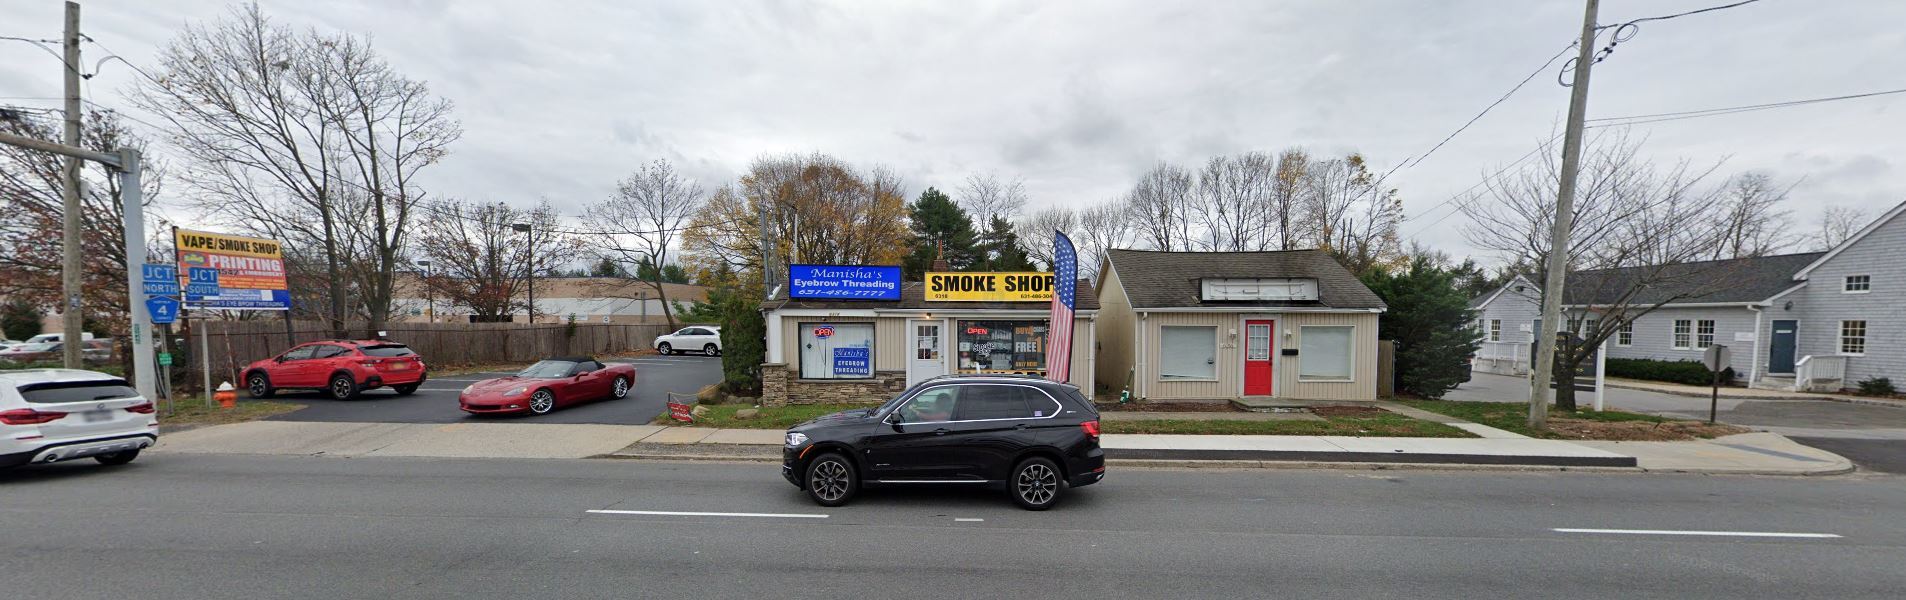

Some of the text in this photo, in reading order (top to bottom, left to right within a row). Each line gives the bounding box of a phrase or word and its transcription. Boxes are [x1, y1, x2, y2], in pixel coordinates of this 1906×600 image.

[181, 234, 278, 255] VAPE/SMOKE SHOP
[209, 254, 282, 272] PRINTING
[144, 267, 172, 279] JCT
[191, 269, 216, 281] JCT
[810, 267, 883, 279] Manisha's
[143, 284, 178, 293] NORTH
[794, 279, 895, 290] Eyebrow Threading
[931, 275, 1055, 292] SMOKE SHOP
[188, 285, 219, 294] SOUTH
[798, 289, 886, 297] 631-486-7777
[157, 305, 168, 316] 4
[813, 328, 835, 336] OPEN
[967, 327, 988, 335] OPEN
[1015, 341, 1037, 353] FREE
